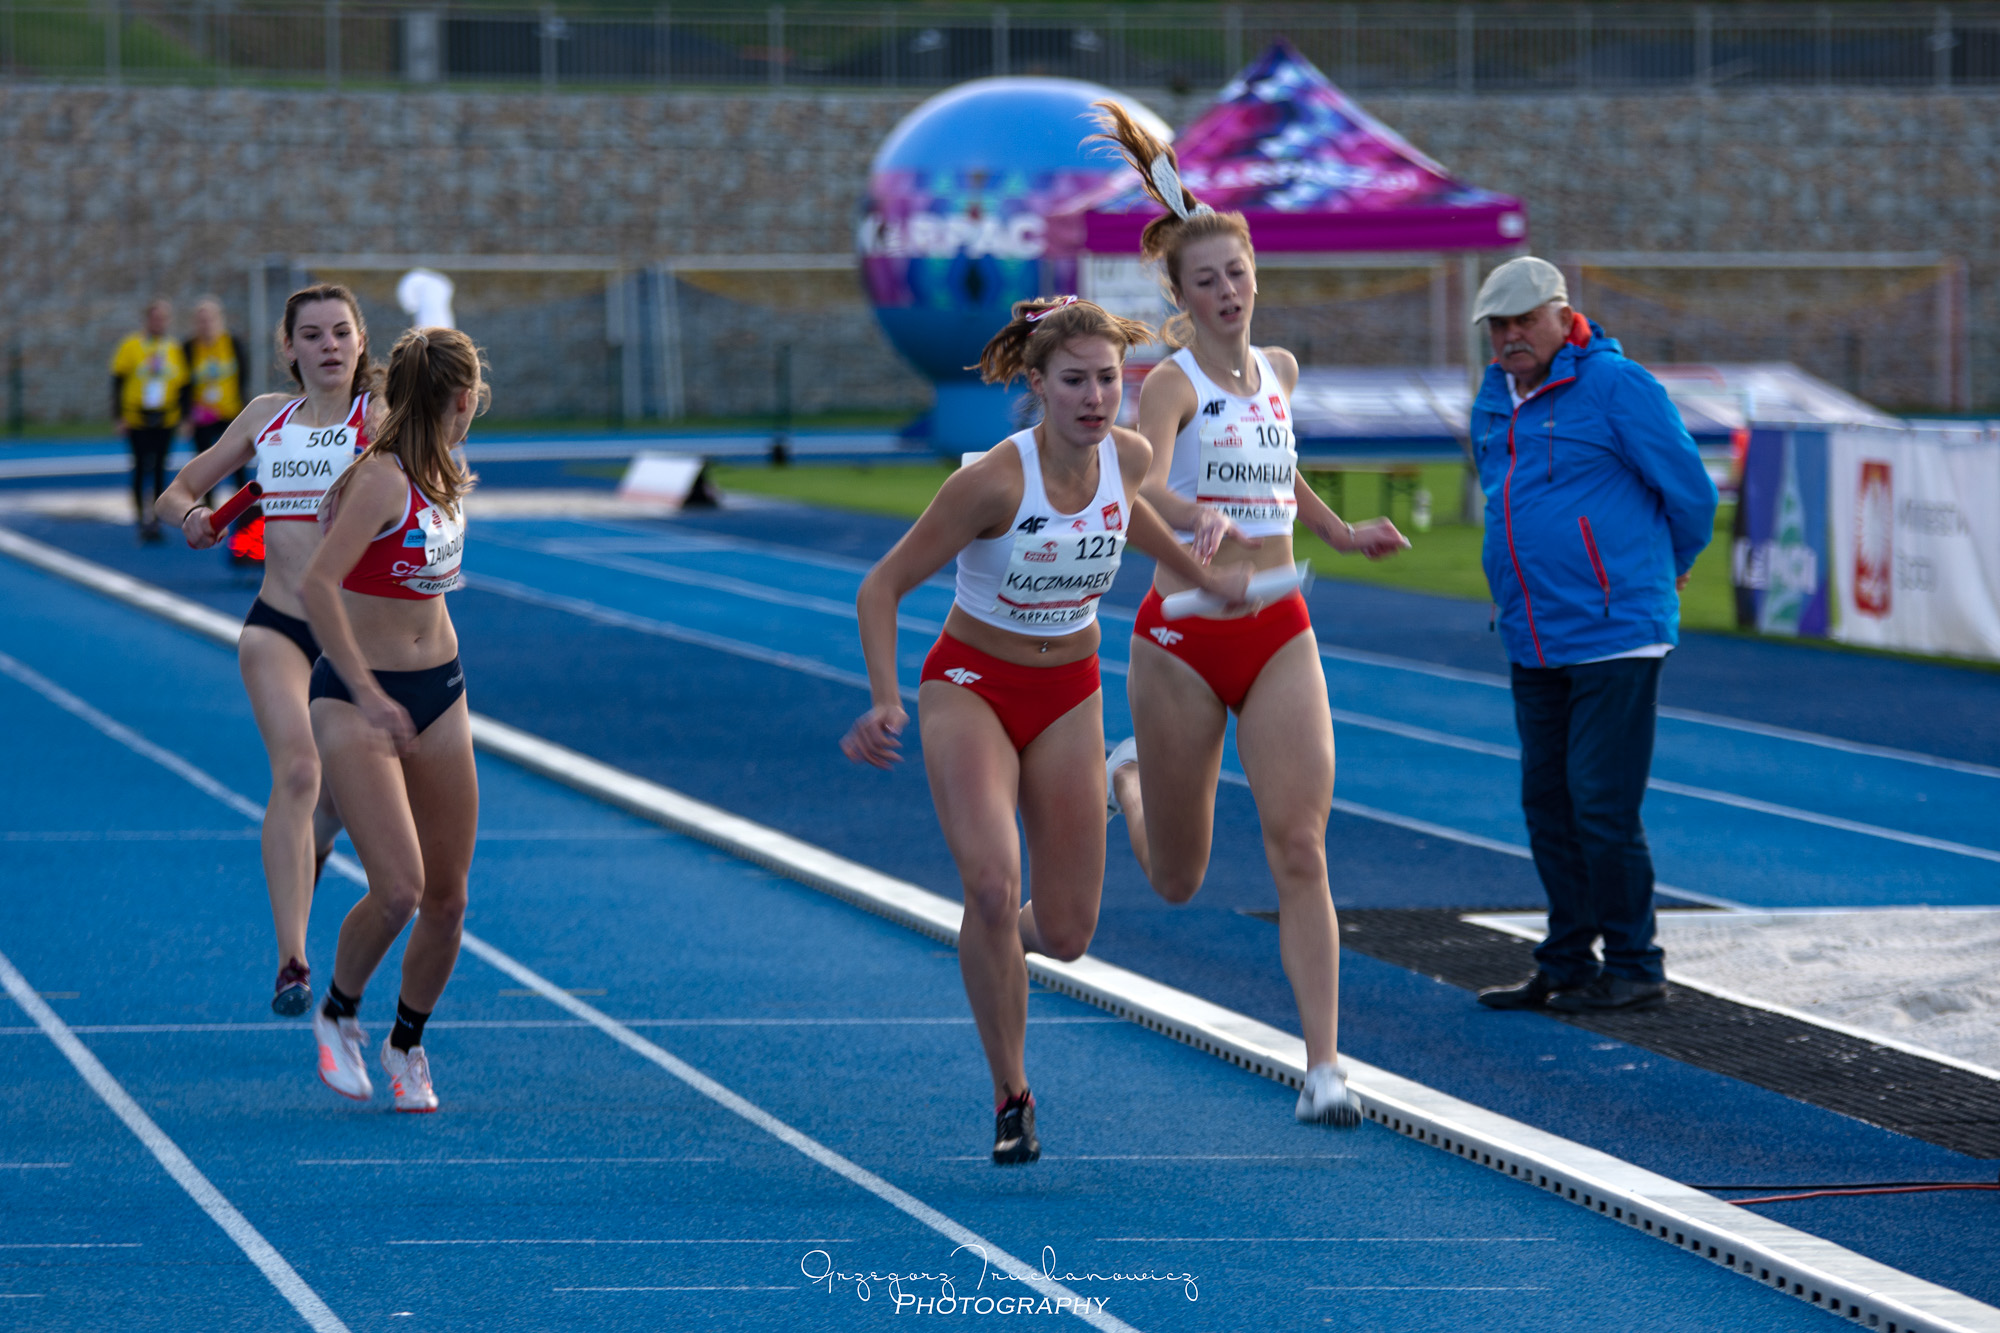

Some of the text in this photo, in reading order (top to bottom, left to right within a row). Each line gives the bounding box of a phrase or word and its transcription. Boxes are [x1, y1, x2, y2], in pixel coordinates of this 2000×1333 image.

[1203, 399, 1226, 417] 4F
[306, 427, 347, 448] 506
[1256, 424, 1288, 449] 107
[272, 459, 333, 478] BISOVA
[1206, 461, 1292, 484] FORMELLA
[265, 499, 314, 511] KARPACZ
[1215, 505, 1266, 520] ARPACZ
[1017, 515, 1050, 535] 4F
[1074, 535, 1118, 561] 121
[1006, 570, 1115, 593] KACZMAREK
[1009, 608, 1068, 623] KARPACZ
[1150, 626, 1184, 646] 4F
[944, 667, 983, 685] 4F
